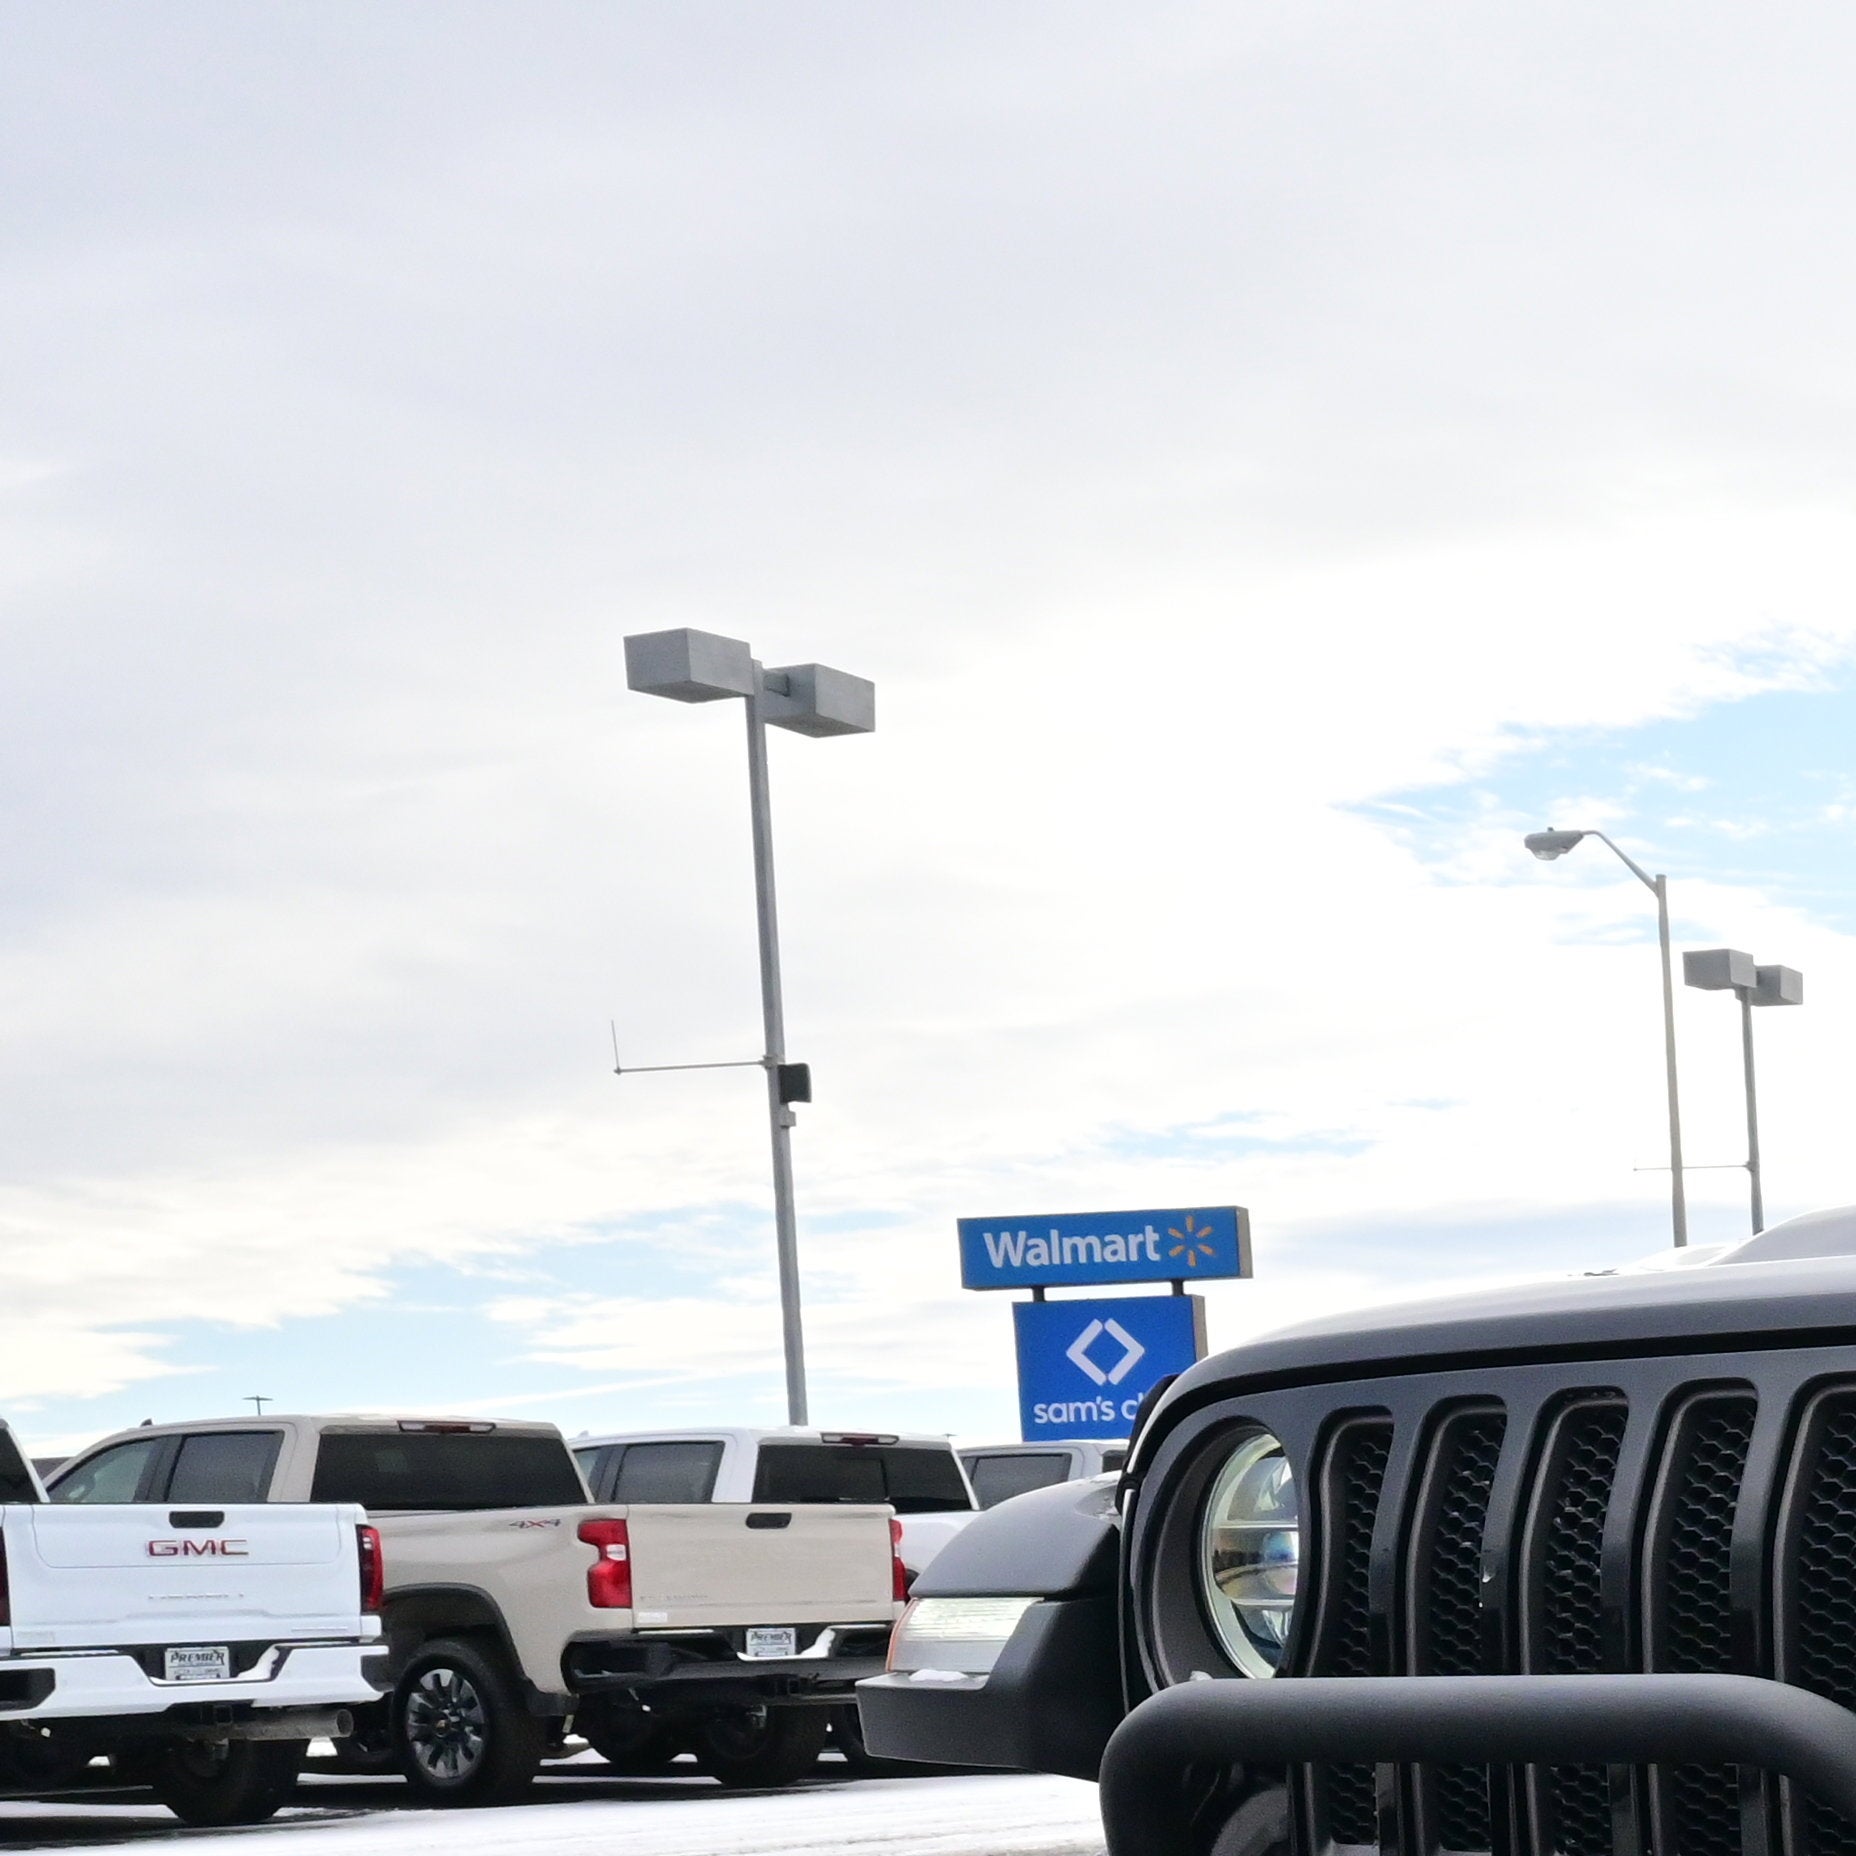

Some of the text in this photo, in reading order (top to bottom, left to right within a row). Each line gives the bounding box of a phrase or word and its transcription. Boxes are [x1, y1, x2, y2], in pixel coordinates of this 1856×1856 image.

[983, 1225, 1160, 1268] Walmart
[1034, 1395, 1115, 1424] sam's
[147, 1539, 249, 1557] GMC
